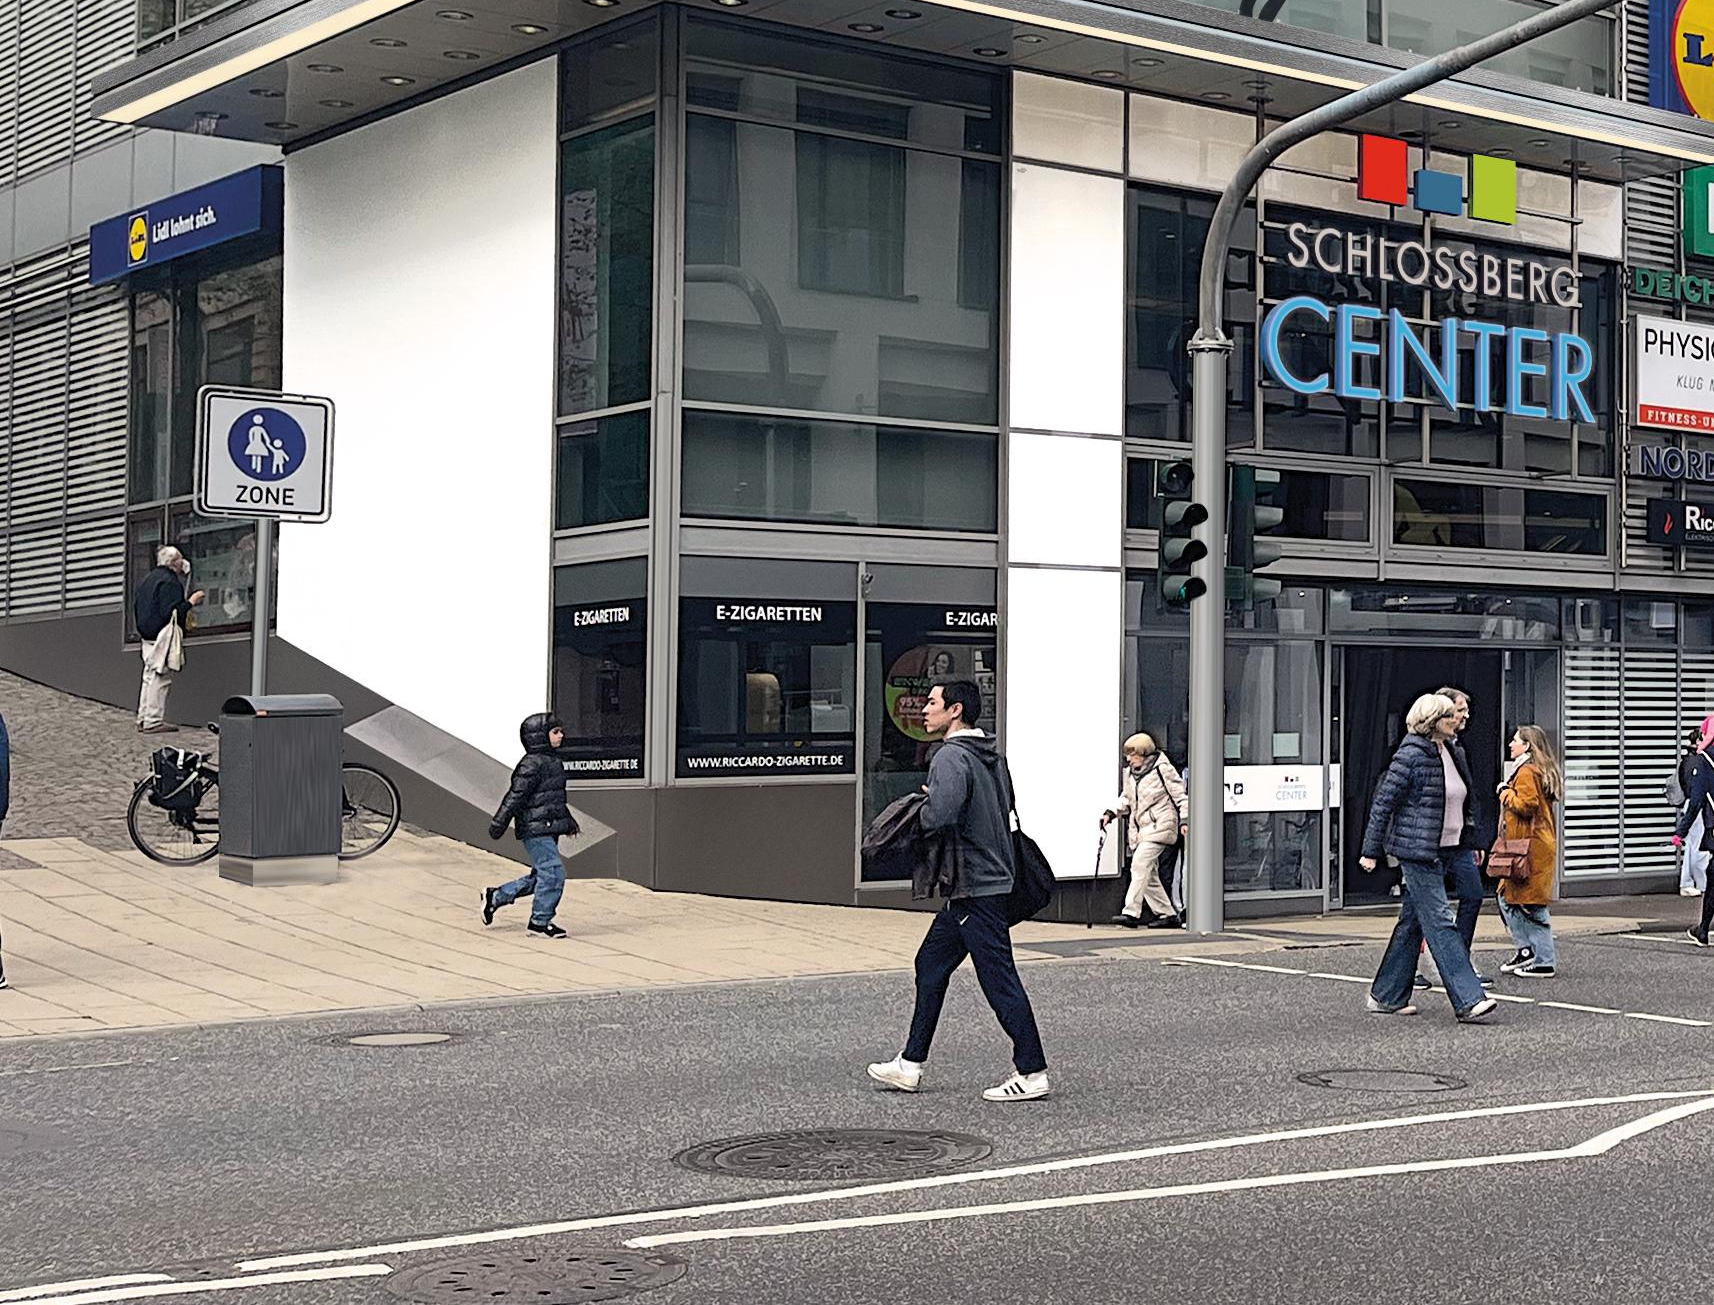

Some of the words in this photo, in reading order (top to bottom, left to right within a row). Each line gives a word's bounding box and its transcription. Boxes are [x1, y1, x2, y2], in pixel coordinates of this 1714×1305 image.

[153, 222, 170, 243] Lidl
[170, 213, 194, 237] lohnt
[1288, 222, 1582, 307] SCHLOSSBERG
[1261, 296, 1597, 423] CENTER
[1676, 374, 1704, 390] KLUG
[236, 485, 294, 506] ZONE
[574, 607, 629, 626] E-ZIGARETTEN
[716, 605, 822, 622] E-ZIGARETTEN
[688, 755, 843, 768] WWW.RICCARDO-ZIGARETTE.DE
